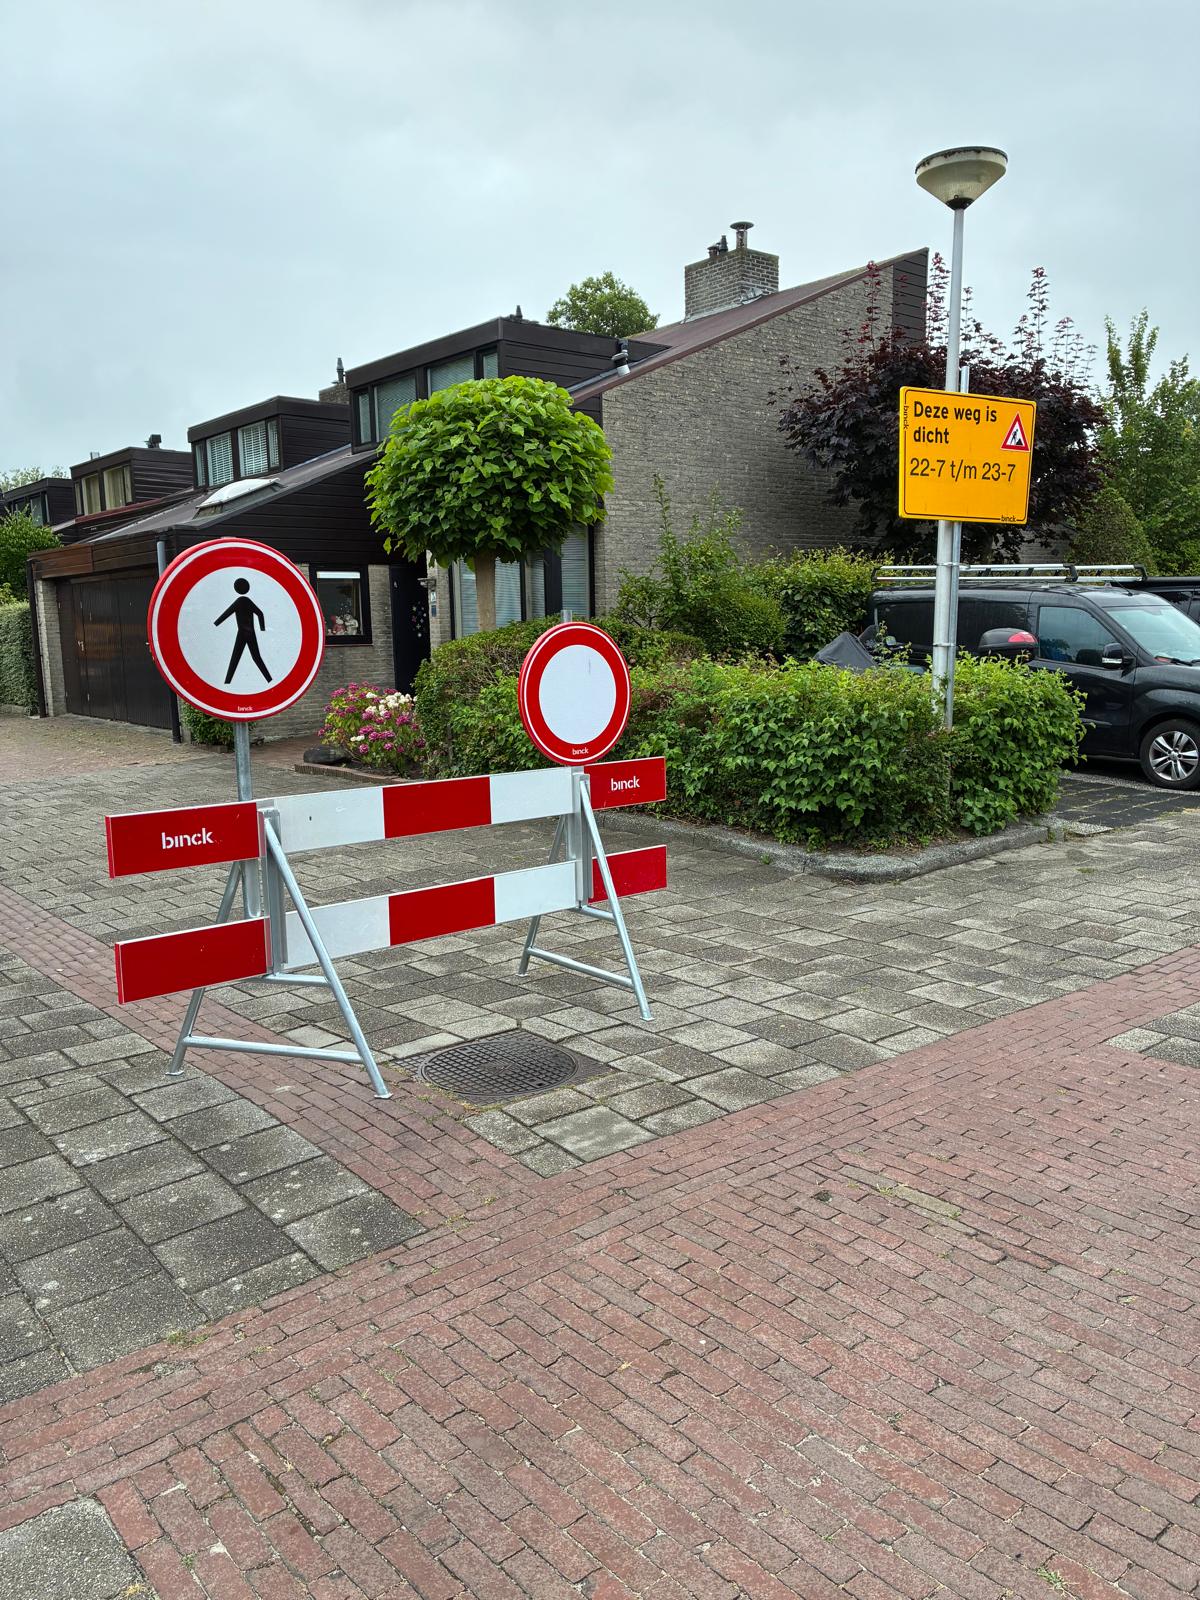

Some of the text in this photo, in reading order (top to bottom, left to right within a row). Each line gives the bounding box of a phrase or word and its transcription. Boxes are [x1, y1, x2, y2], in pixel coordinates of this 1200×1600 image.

[914, 401, 998, 425] Deze weg is
[913, 426, 950, 444] dicht
[910, 457, 1016, 482] 22-7 t/m 23-7
[610, 775, 641, 791] binck
[161, 827, 214, 850] binck
